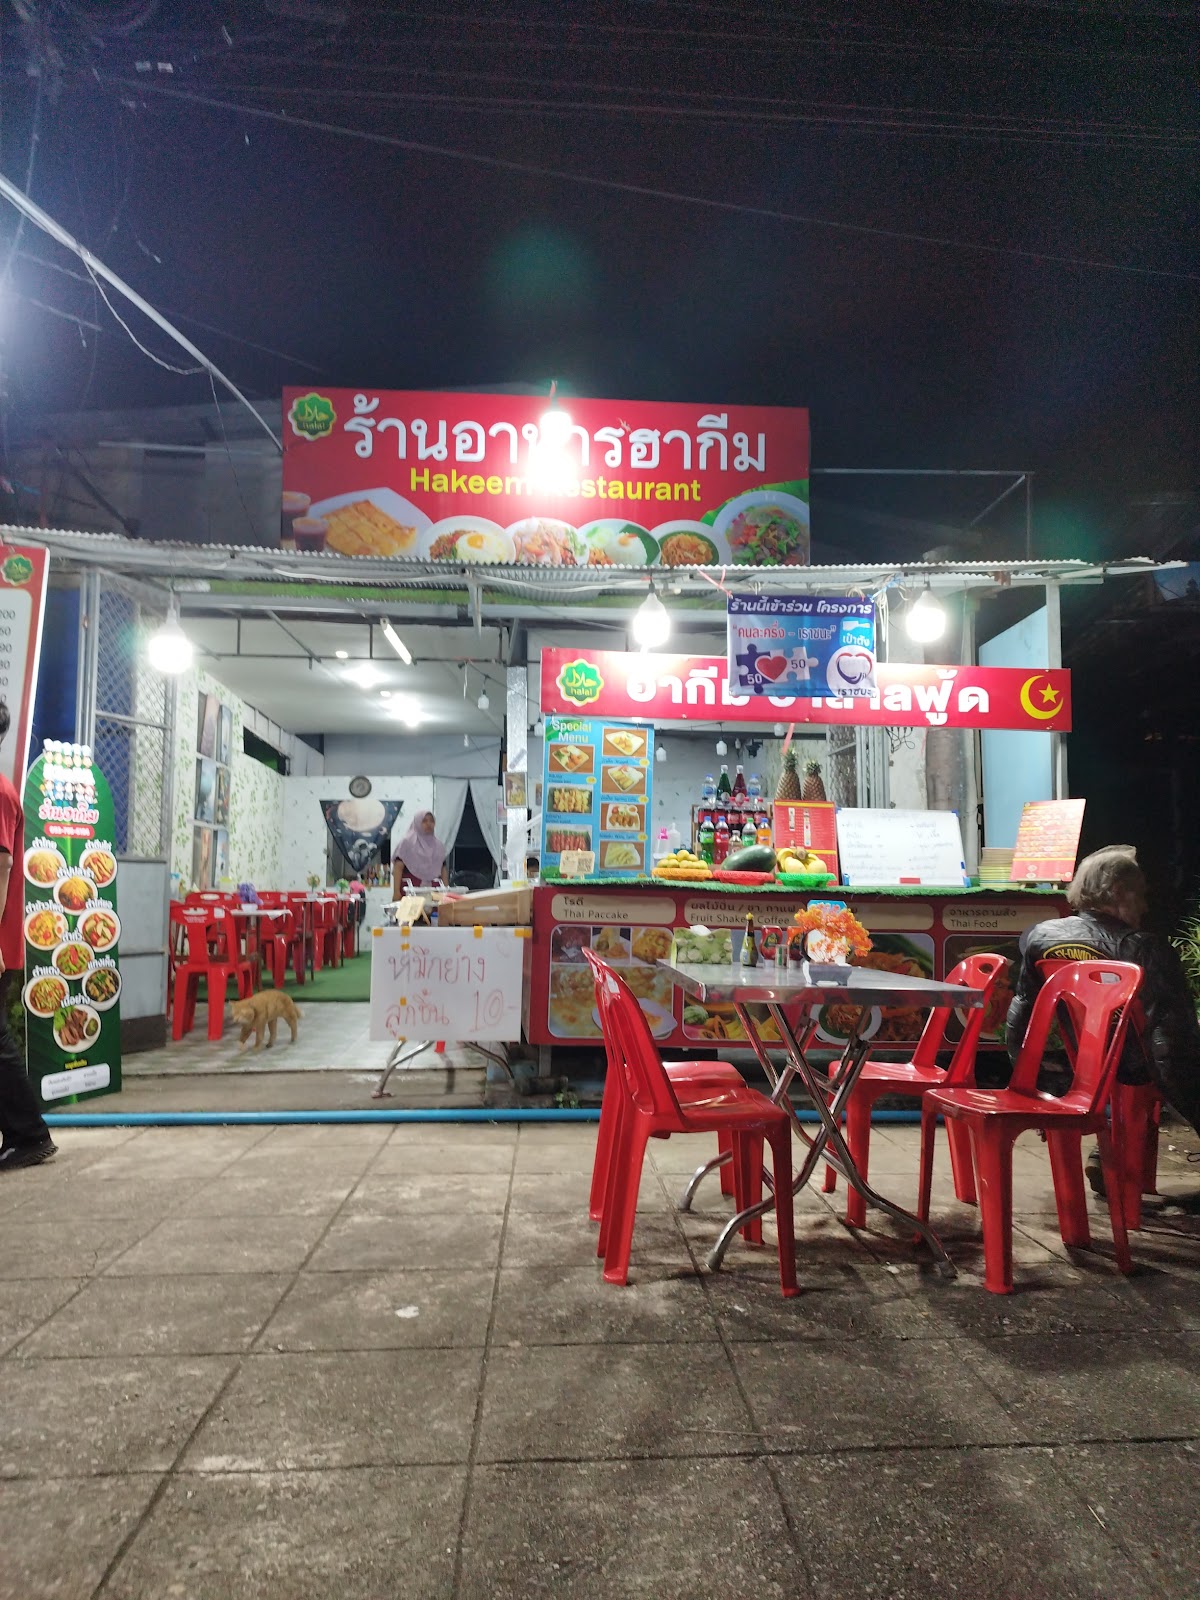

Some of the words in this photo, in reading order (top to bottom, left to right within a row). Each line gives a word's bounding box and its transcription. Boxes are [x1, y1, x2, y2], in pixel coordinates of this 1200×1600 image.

[410, 467, 534, 496] Hakeem
[560, 475, 701, 502] estaurant
[730, 595, 812, 613] ร้านนี้เข้าร่วม
[816, 600, 873, 614] โครงการ
[790, 659, 806, 670] 50
[746, 674, 763, 685] 50
[569, 686, 593, 697] halal
[552, 720, 592, 733] Special
[558, 732, 589, 743] Menu
[563, 896, 584, 906] โรตี
[564, 909, 585, 919] Thai
[690, 913, 713, 924] Fruit
[757, 916, 790, 925] Coffee
[950, 919, 970, 928] Thai
[974, 919, 998, 928] Food
[388, 943, 486, 984] หมึกย่าง
